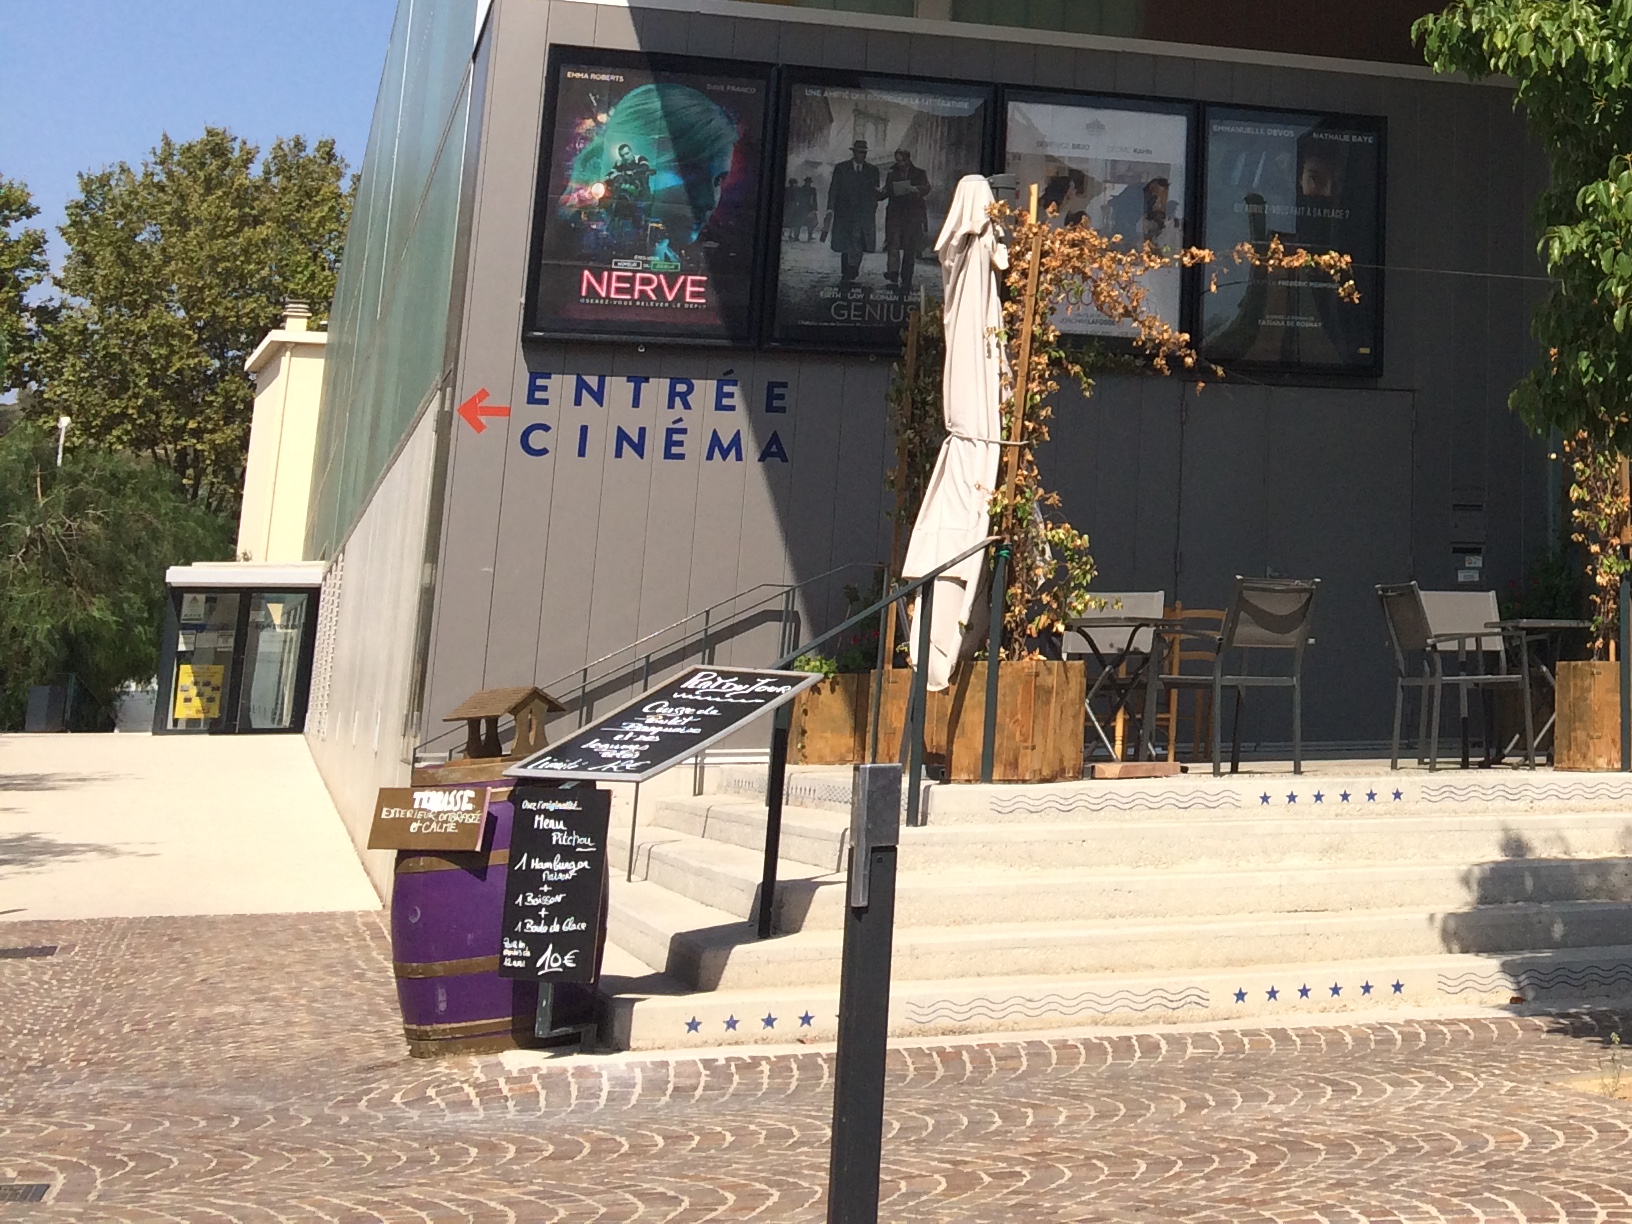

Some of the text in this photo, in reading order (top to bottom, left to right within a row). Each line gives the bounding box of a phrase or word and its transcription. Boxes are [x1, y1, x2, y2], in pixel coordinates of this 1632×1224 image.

[567, 71, 624, 82] EMMA ROBERTS
[1212, 124, 1295, 138] EMMANUELLE DEVOS
[1312, 131, 1349, 142] NATHALIE
[1323, 208, 1344, 219] PLACE
[580, 269, 708, 303] NERVE
[526, 368, 789, 414] ENTRÉE
[519, 417, 789, 463] CINÉMA
[533, 814, 567, 829] Menu
[551, 830, 596, 846] Pitchou
[530, 854, 592, 872] Hamburger
[536, 943, 580, 971] 10€
